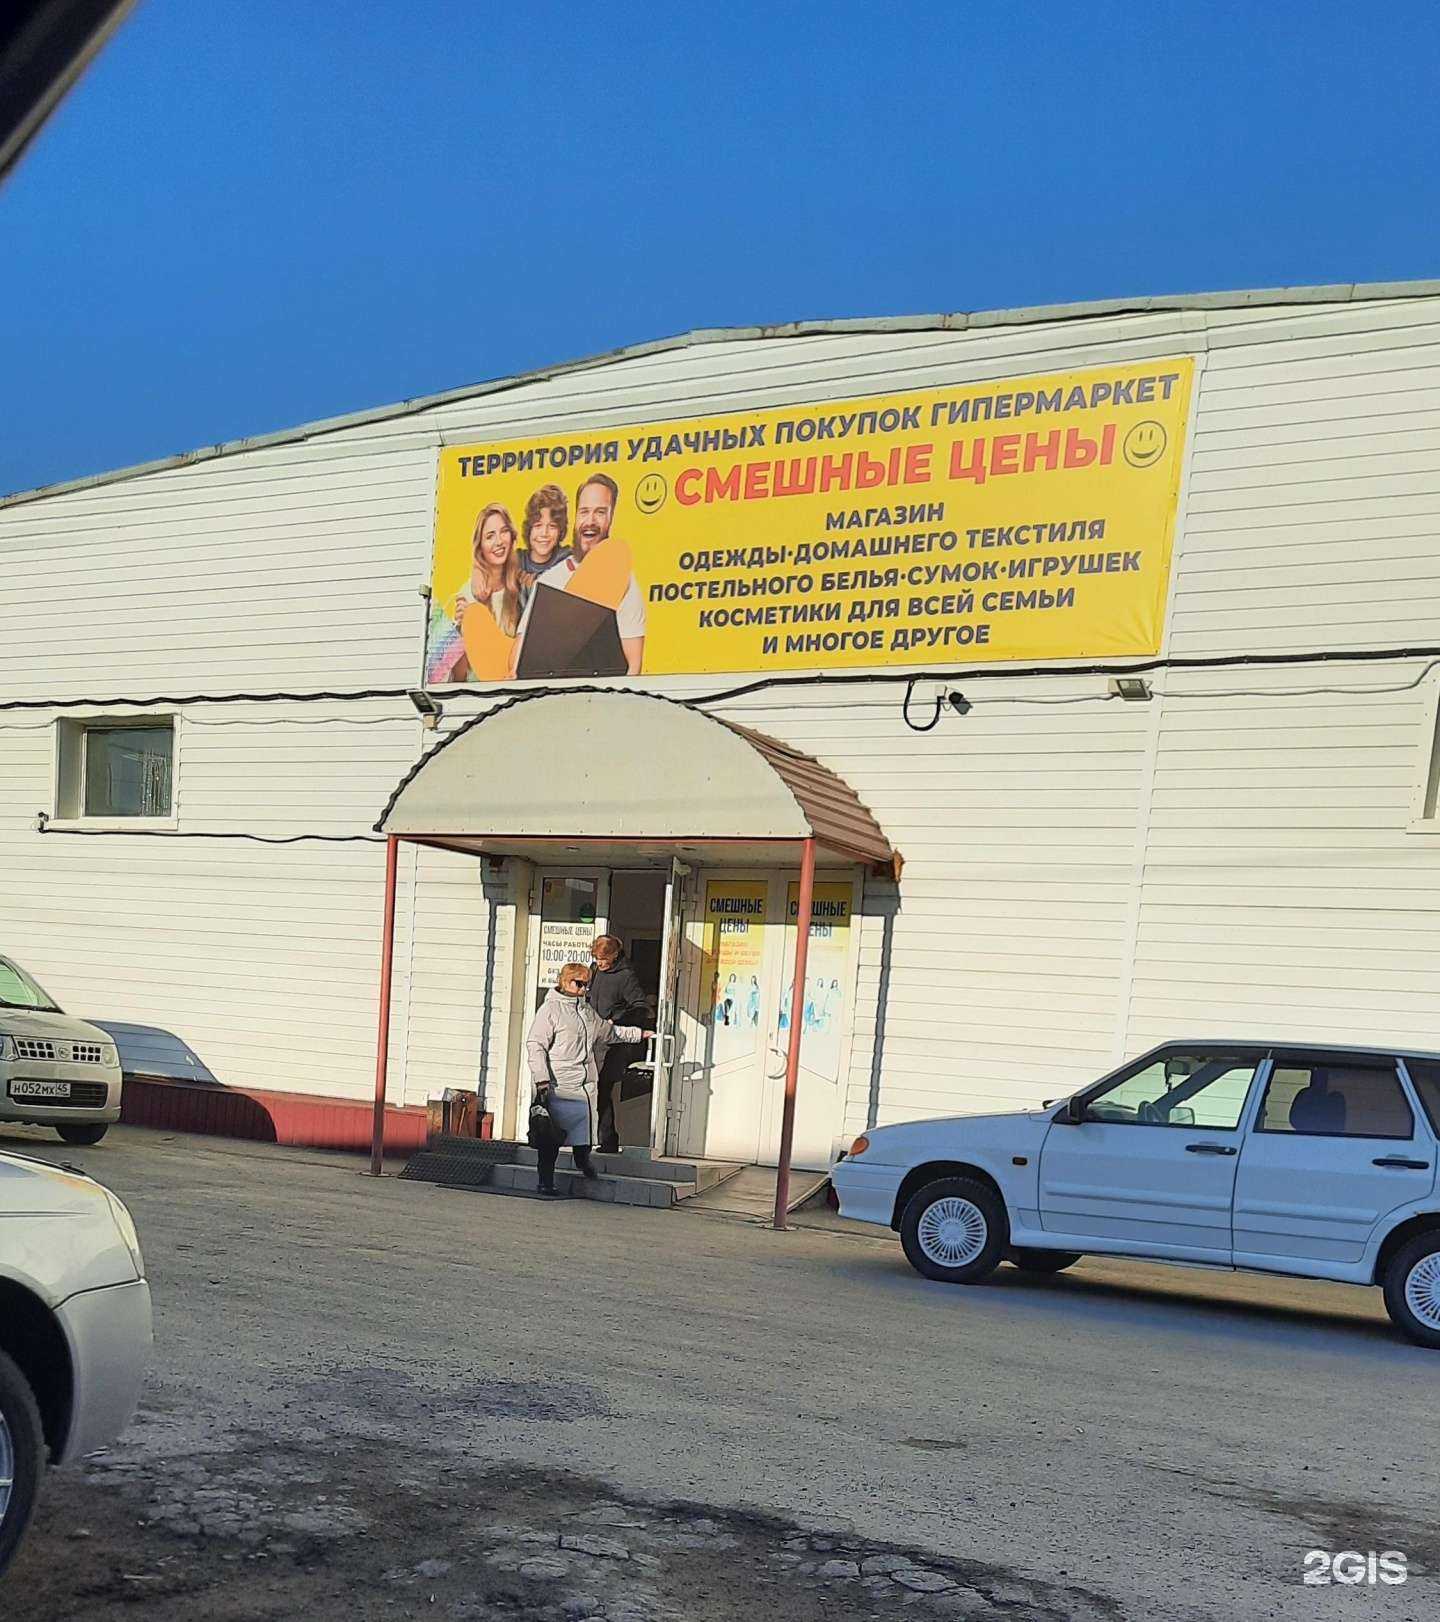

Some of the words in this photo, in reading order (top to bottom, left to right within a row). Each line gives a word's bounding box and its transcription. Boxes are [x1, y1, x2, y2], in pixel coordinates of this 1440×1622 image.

[458, 440, 619, 477] ТЕРРИТОРИЯ
[627, 424, 767, 462] УДАЧНЫХ
[775, 405, 922, 443] ПОКУПОК
[931, 373, 1180, 426] ГИПЕРМАРКЕТ
[674, 443, 934, 506] СМЕШНЫЕ
[948, 423, 1118, 485] ЦЕНЫ
[825, 502, 945, 531] МАГАЗИН
[966, 519, 1106, 549] ТЕКСТИЛЯ
[649, 574, 814, 602] ПОСТЕЛЬНОГО
[699, 601, 841, 628] КОСМЕТИКИ
[848, 597, 899, 623] ДЛЯ
[908, 589, 974, 616] ВСЕЙ
[982, 588, 1075, 613] СЕМЬИ
[762, 636, 778, 654] И
[785, 630, 884, 653] МНОГОЕ
[891, 625, 990, 651] ДРУГОЕ
[710, 898, 763, 913] СМЕШНЫЕ
[790, 900, 847, 916] СШНЫЕ
[719, 918, 750, 933] ЦЕНЫ
[808, 922, 832, 937] ЕНЫ
